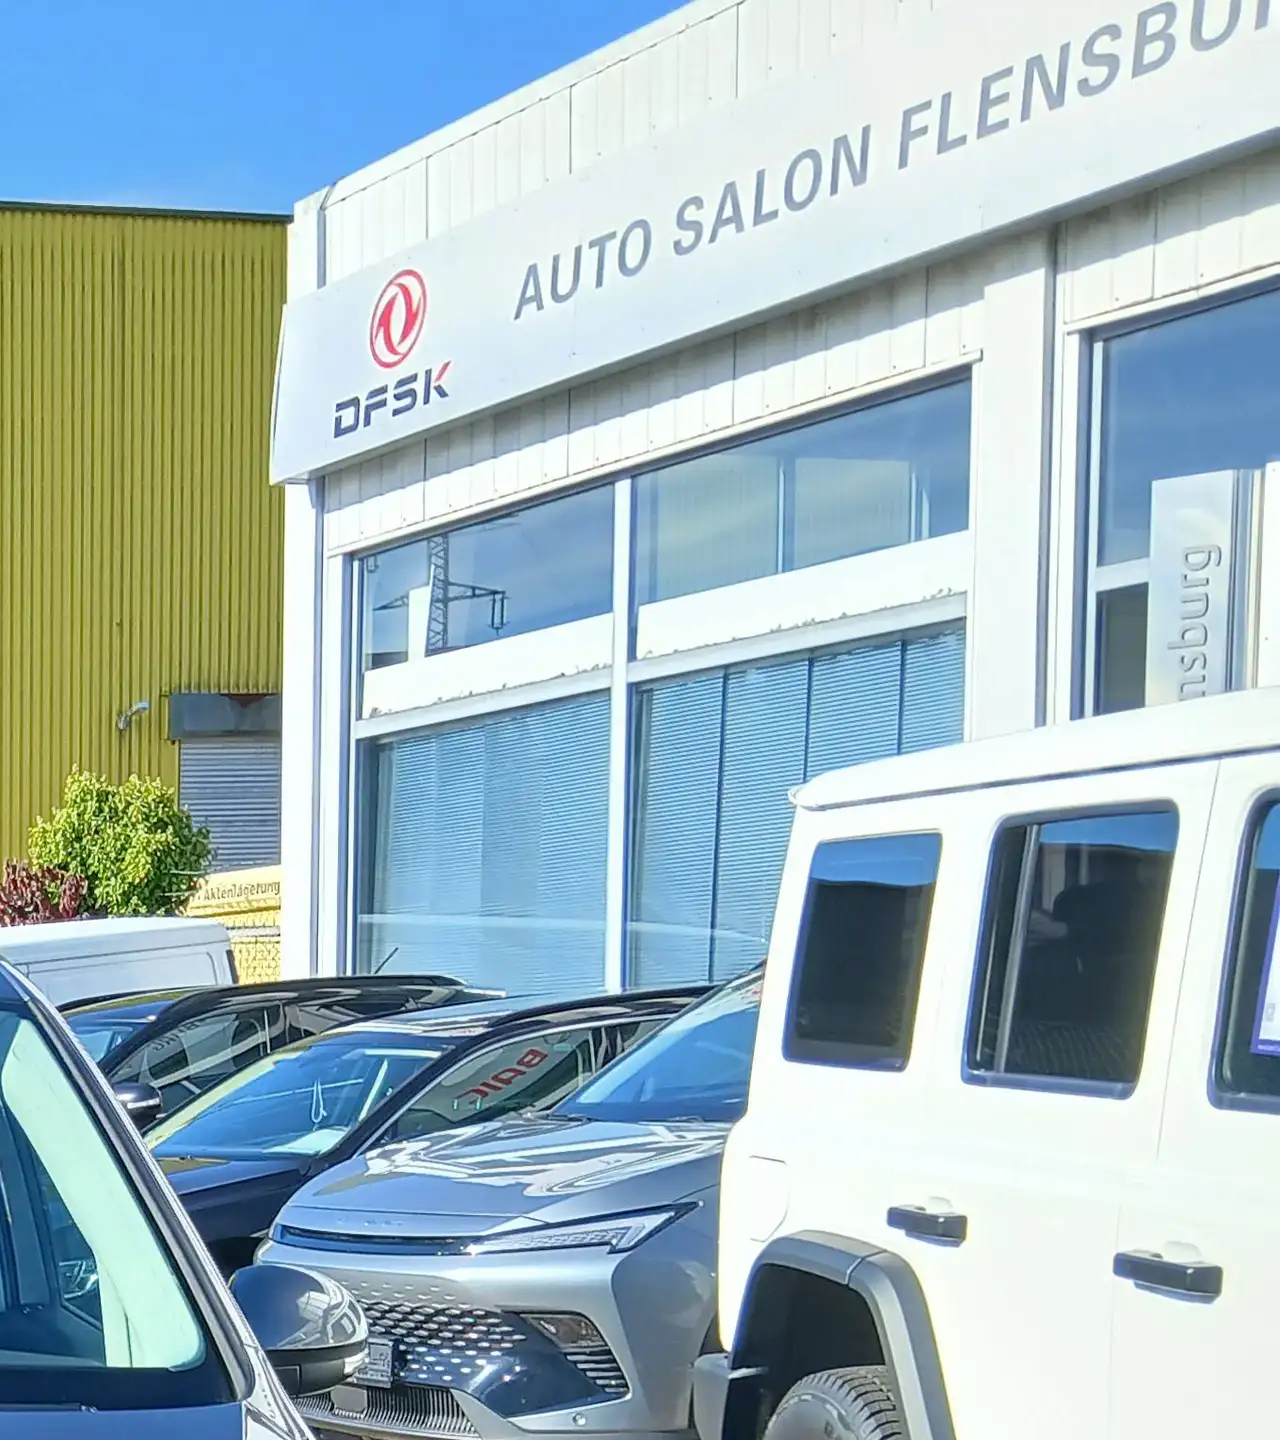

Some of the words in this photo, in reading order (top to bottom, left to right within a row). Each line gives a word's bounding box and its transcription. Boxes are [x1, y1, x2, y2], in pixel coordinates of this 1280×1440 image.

[513, 218, 652, 321] AUTO
[673, 124, 871, 256] SALON
[898, 0, 1272, 171] FLENSBU
[333, 360, 452, 439] DFSK
